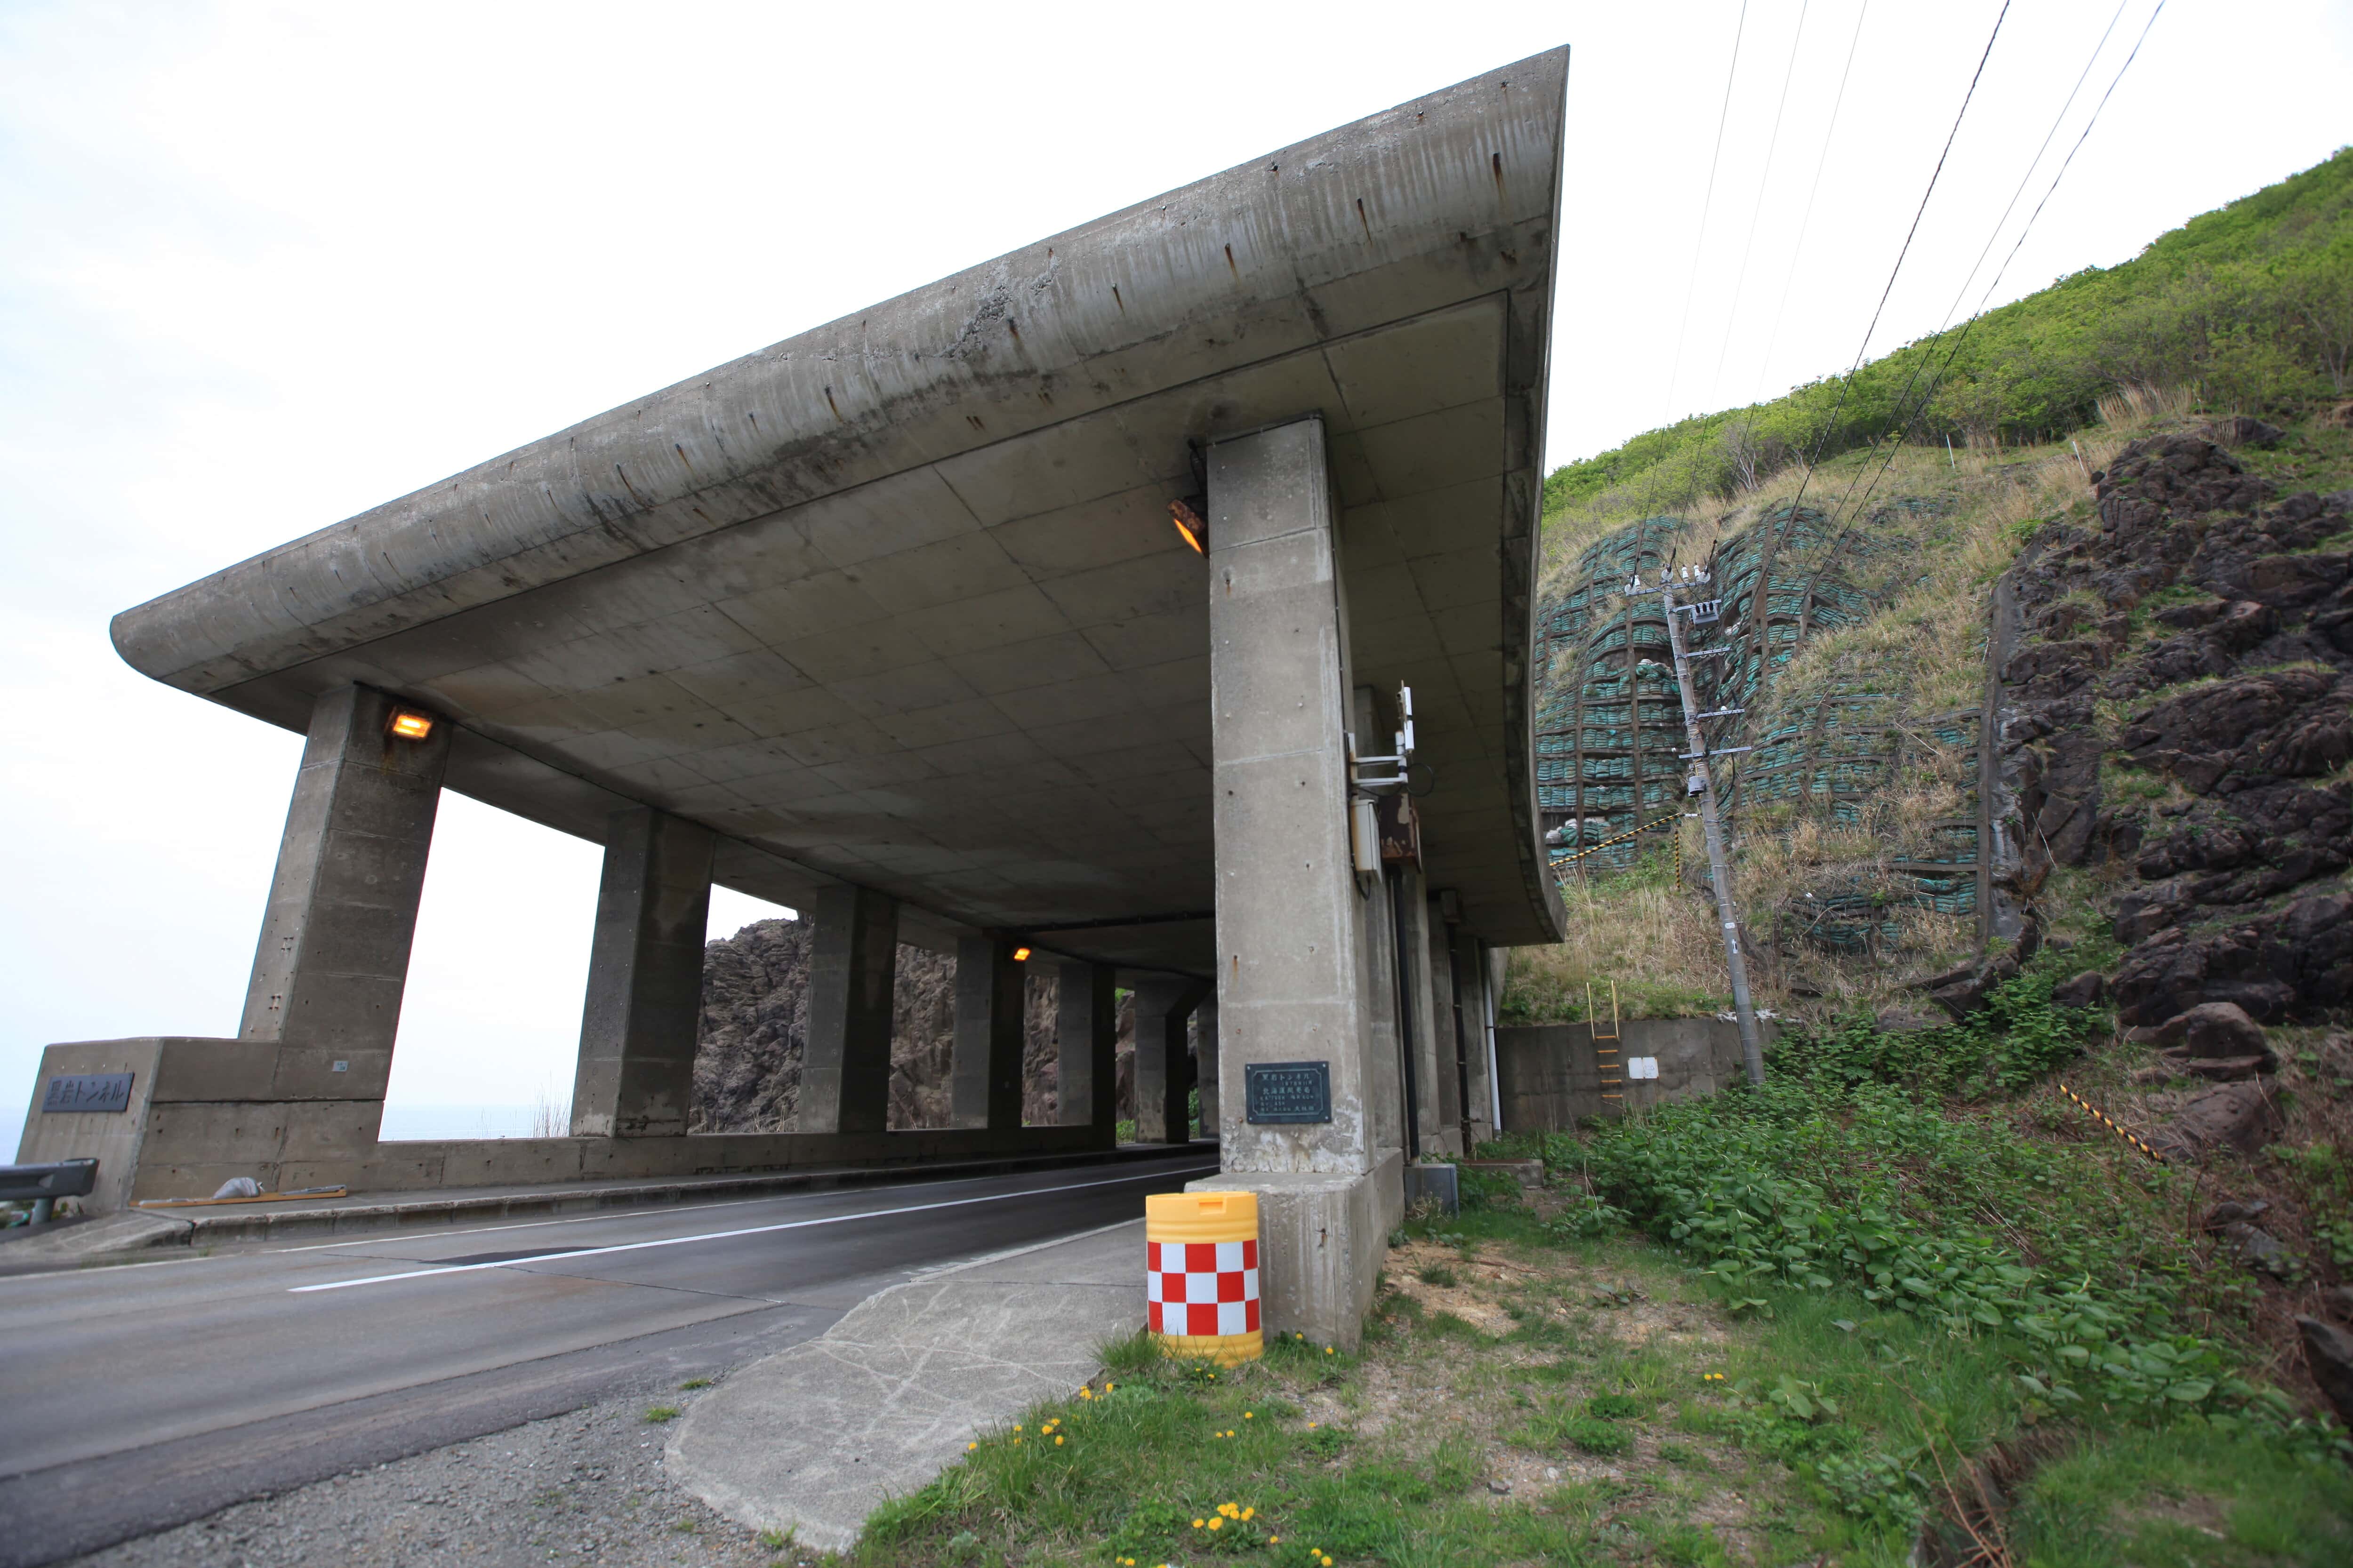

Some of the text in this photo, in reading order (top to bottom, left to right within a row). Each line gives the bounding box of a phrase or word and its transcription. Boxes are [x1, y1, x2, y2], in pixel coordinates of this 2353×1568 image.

[47, 1080, 124, 1106] 黒岩トンネル
